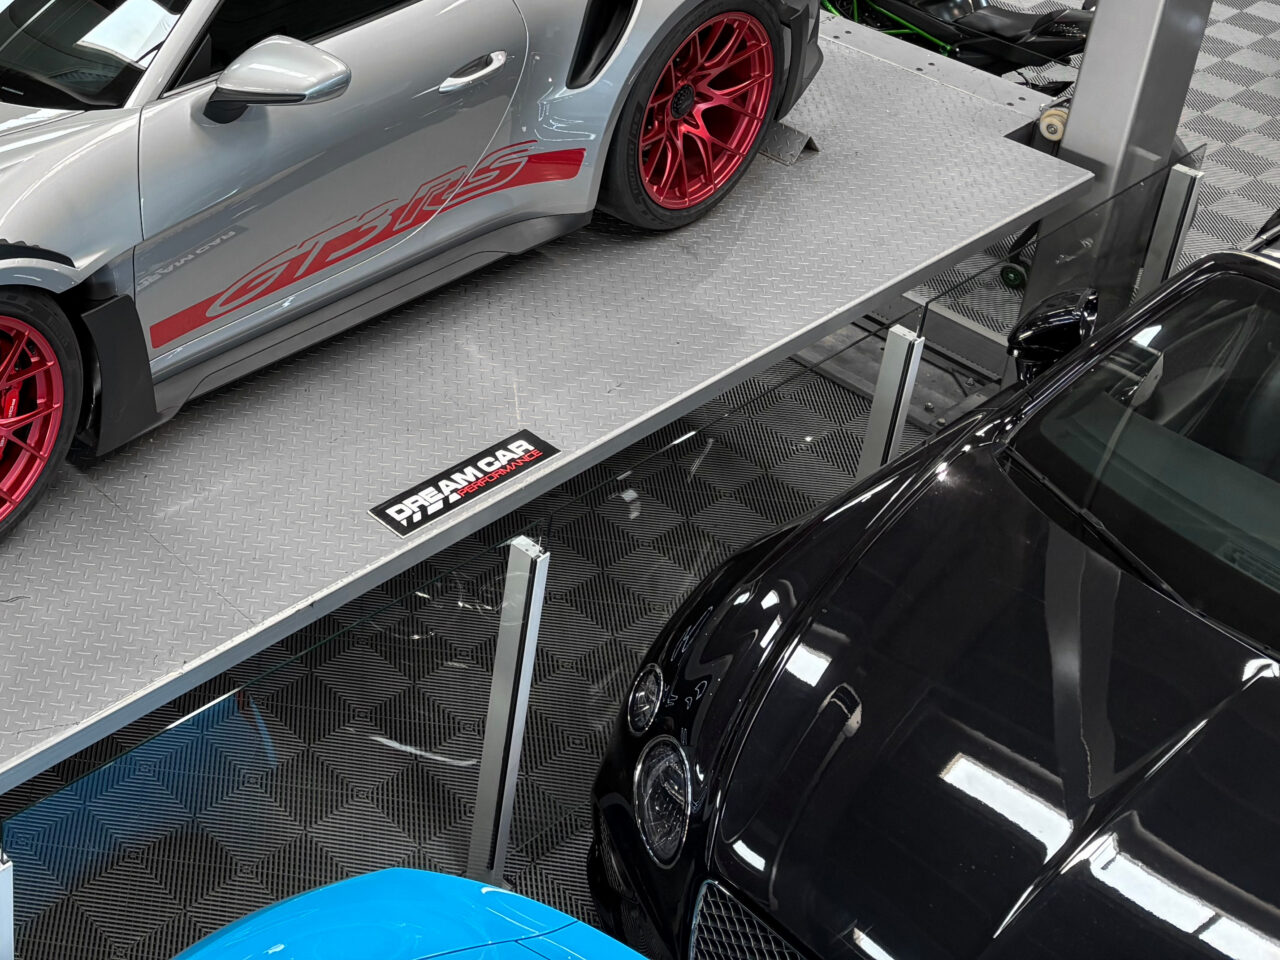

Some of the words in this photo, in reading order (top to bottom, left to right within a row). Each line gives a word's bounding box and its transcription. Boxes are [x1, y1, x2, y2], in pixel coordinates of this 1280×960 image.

[385, 465, 479, 523] DREAM
[476, 440, 536, 473] CAR
[457, 449, 543, 498] PERFORMANCE
